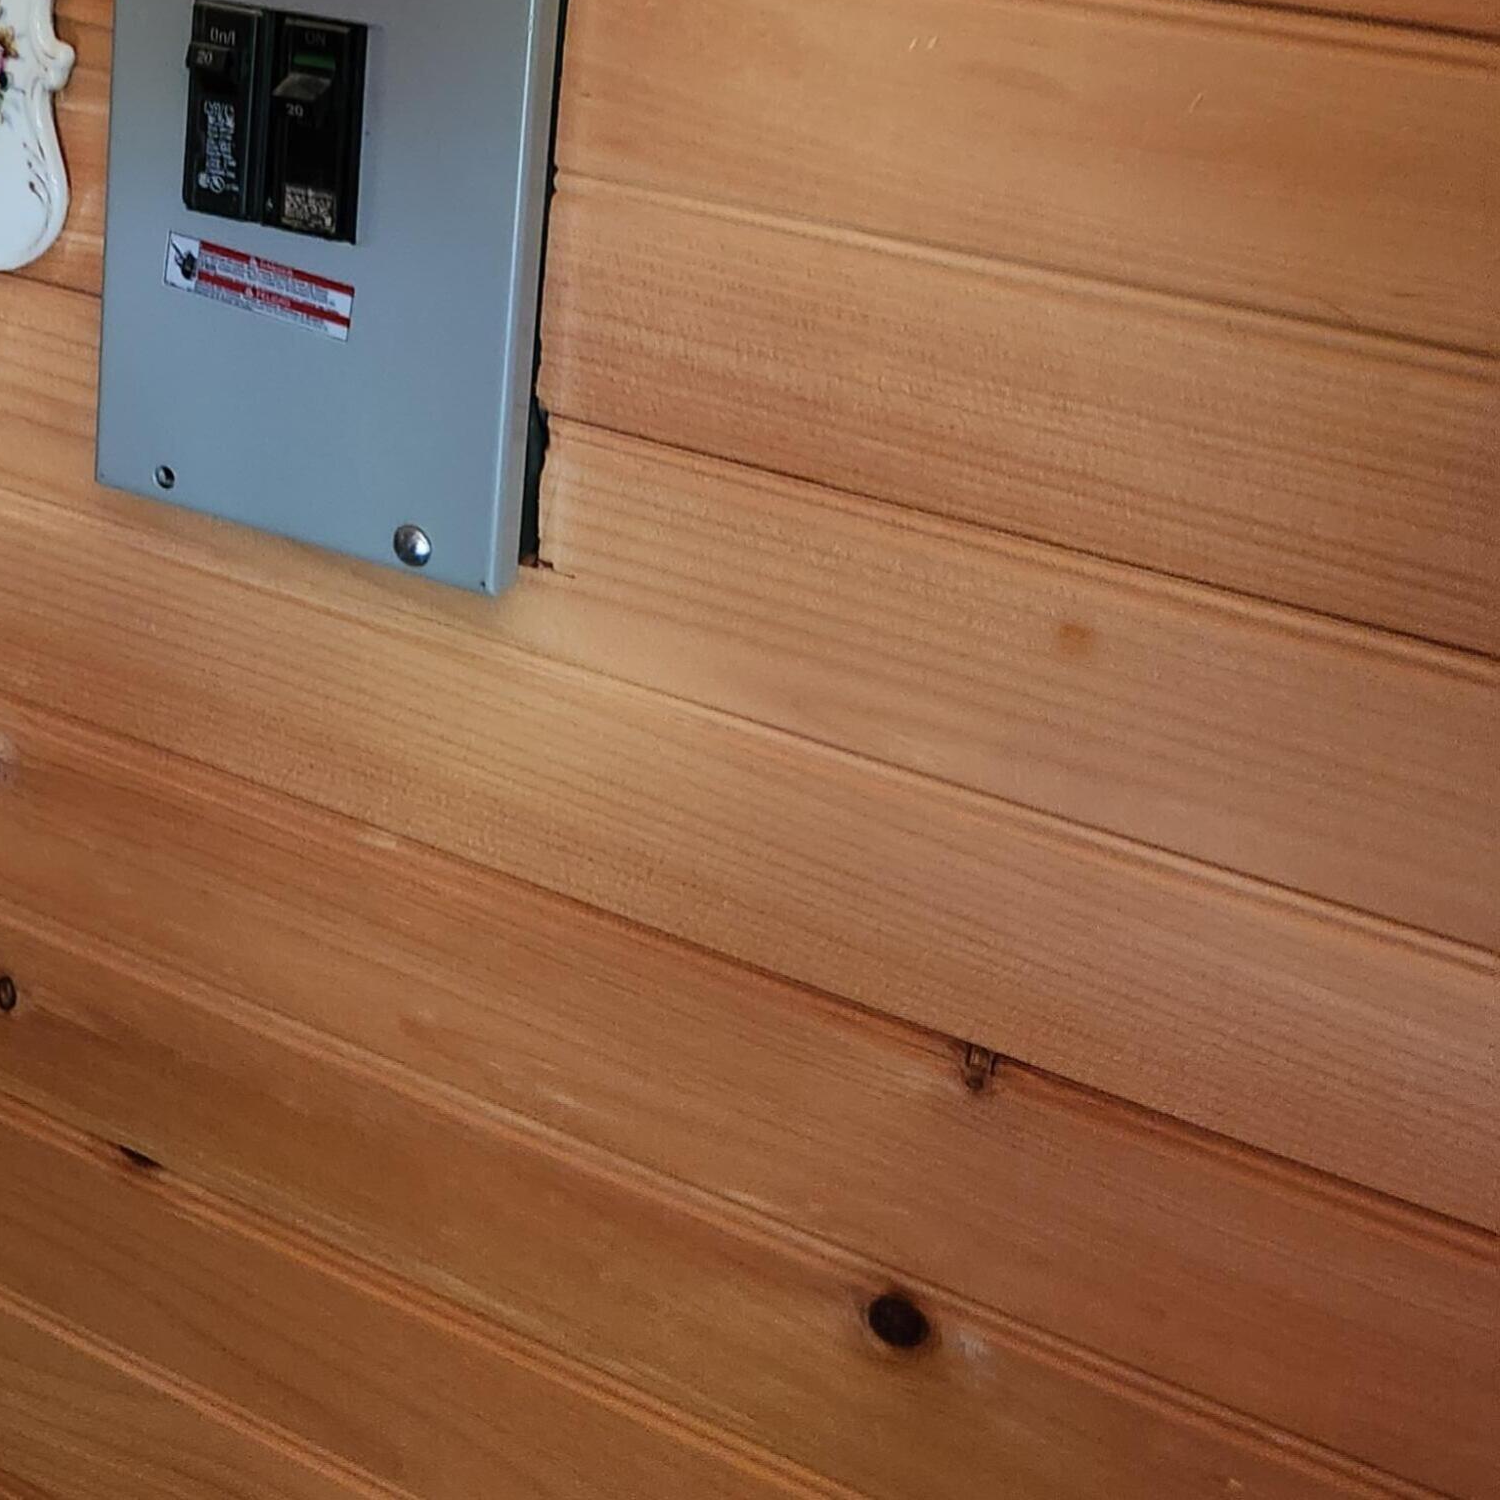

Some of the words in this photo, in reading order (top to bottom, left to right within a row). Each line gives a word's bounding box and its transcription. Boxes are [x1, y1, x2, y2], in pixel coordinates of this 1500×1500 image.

[304, 30, 327, 47] ON
[195, 51, 213, 66] 20
[285, 102, 304, 117] 20
